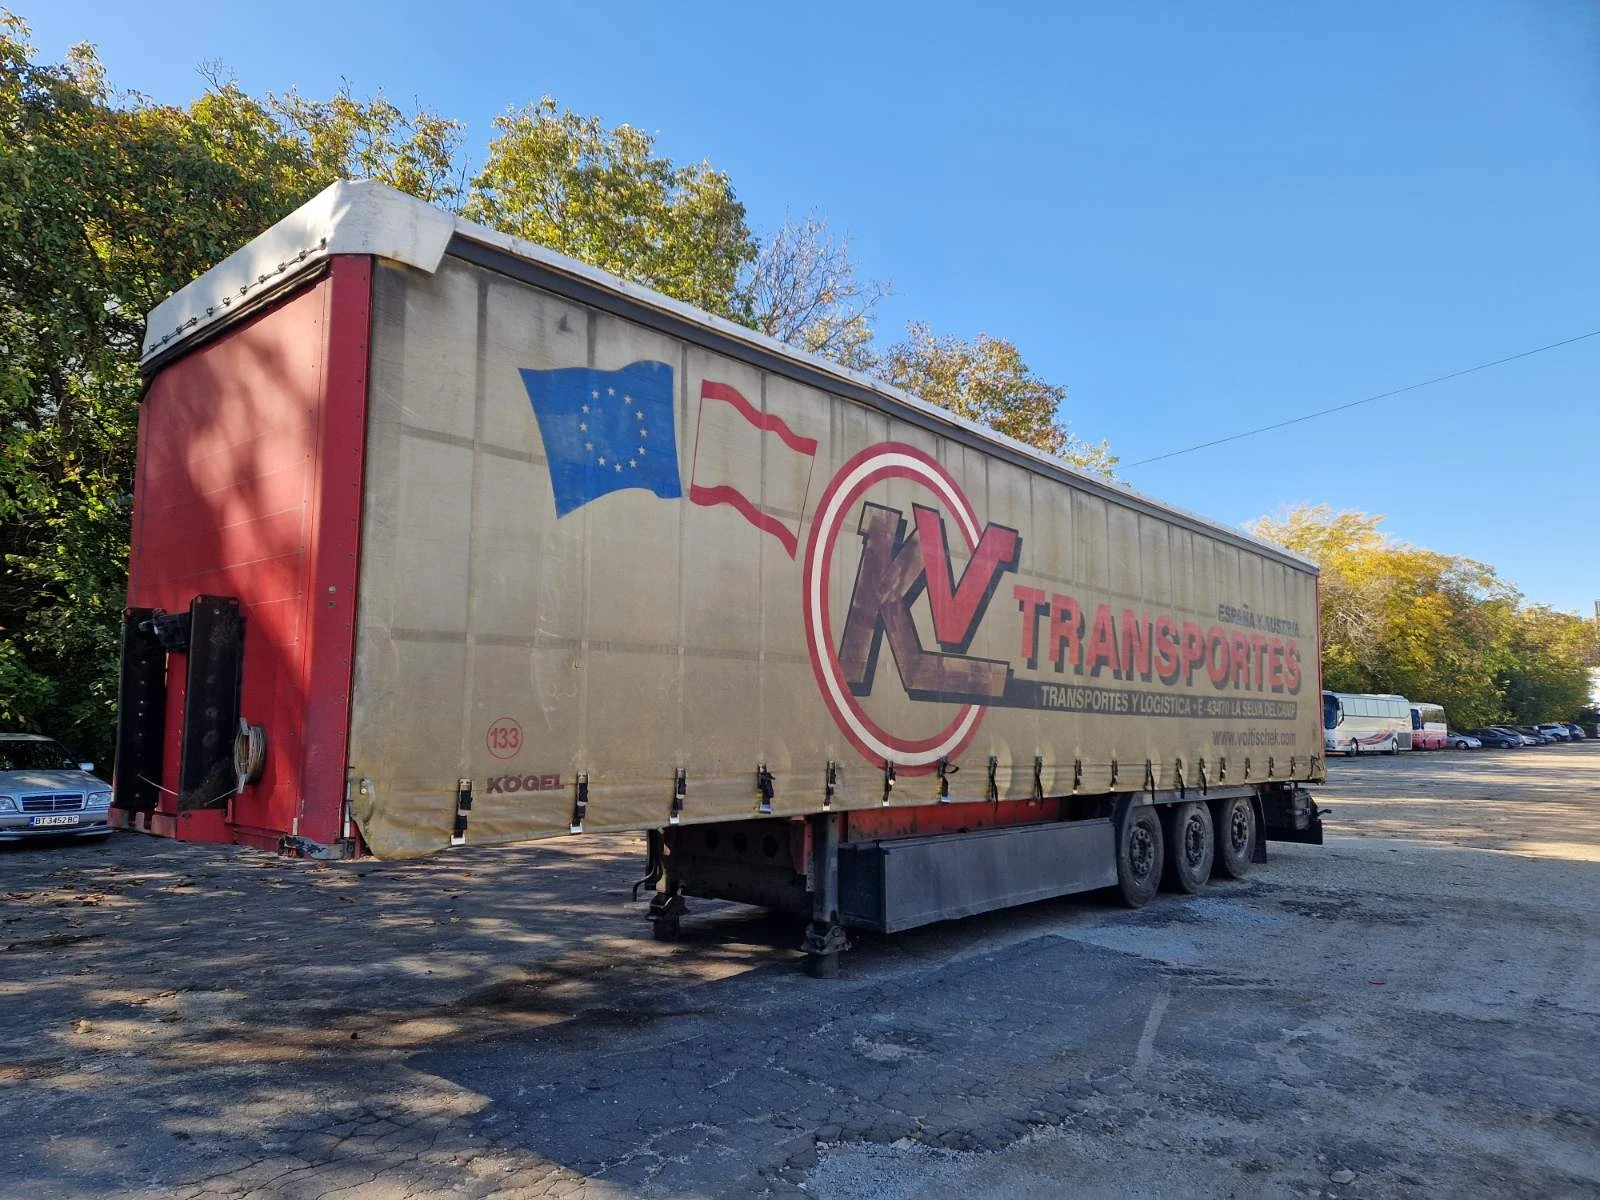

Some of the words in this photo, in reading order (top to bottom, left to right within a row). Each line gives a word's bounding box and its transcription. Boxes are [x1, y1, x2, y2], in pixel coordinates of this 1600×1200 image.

[1218, 603, 1255, 629] ESPAÑA
[1013, 584, 1301, 694] TRANSPORTES
[1041, 685, 1129, 712] TRANSPORTES
[1131, 693, 1139, 713] Y
[1140, 695, 1191, 714] LOGISTICA
[1231, 700, 1240, 717] LA
[1242, 701, 1264, 717] SELVA
[490, 727, 519, 749] 133
[486, 773, 565, 794] KÖGEL
